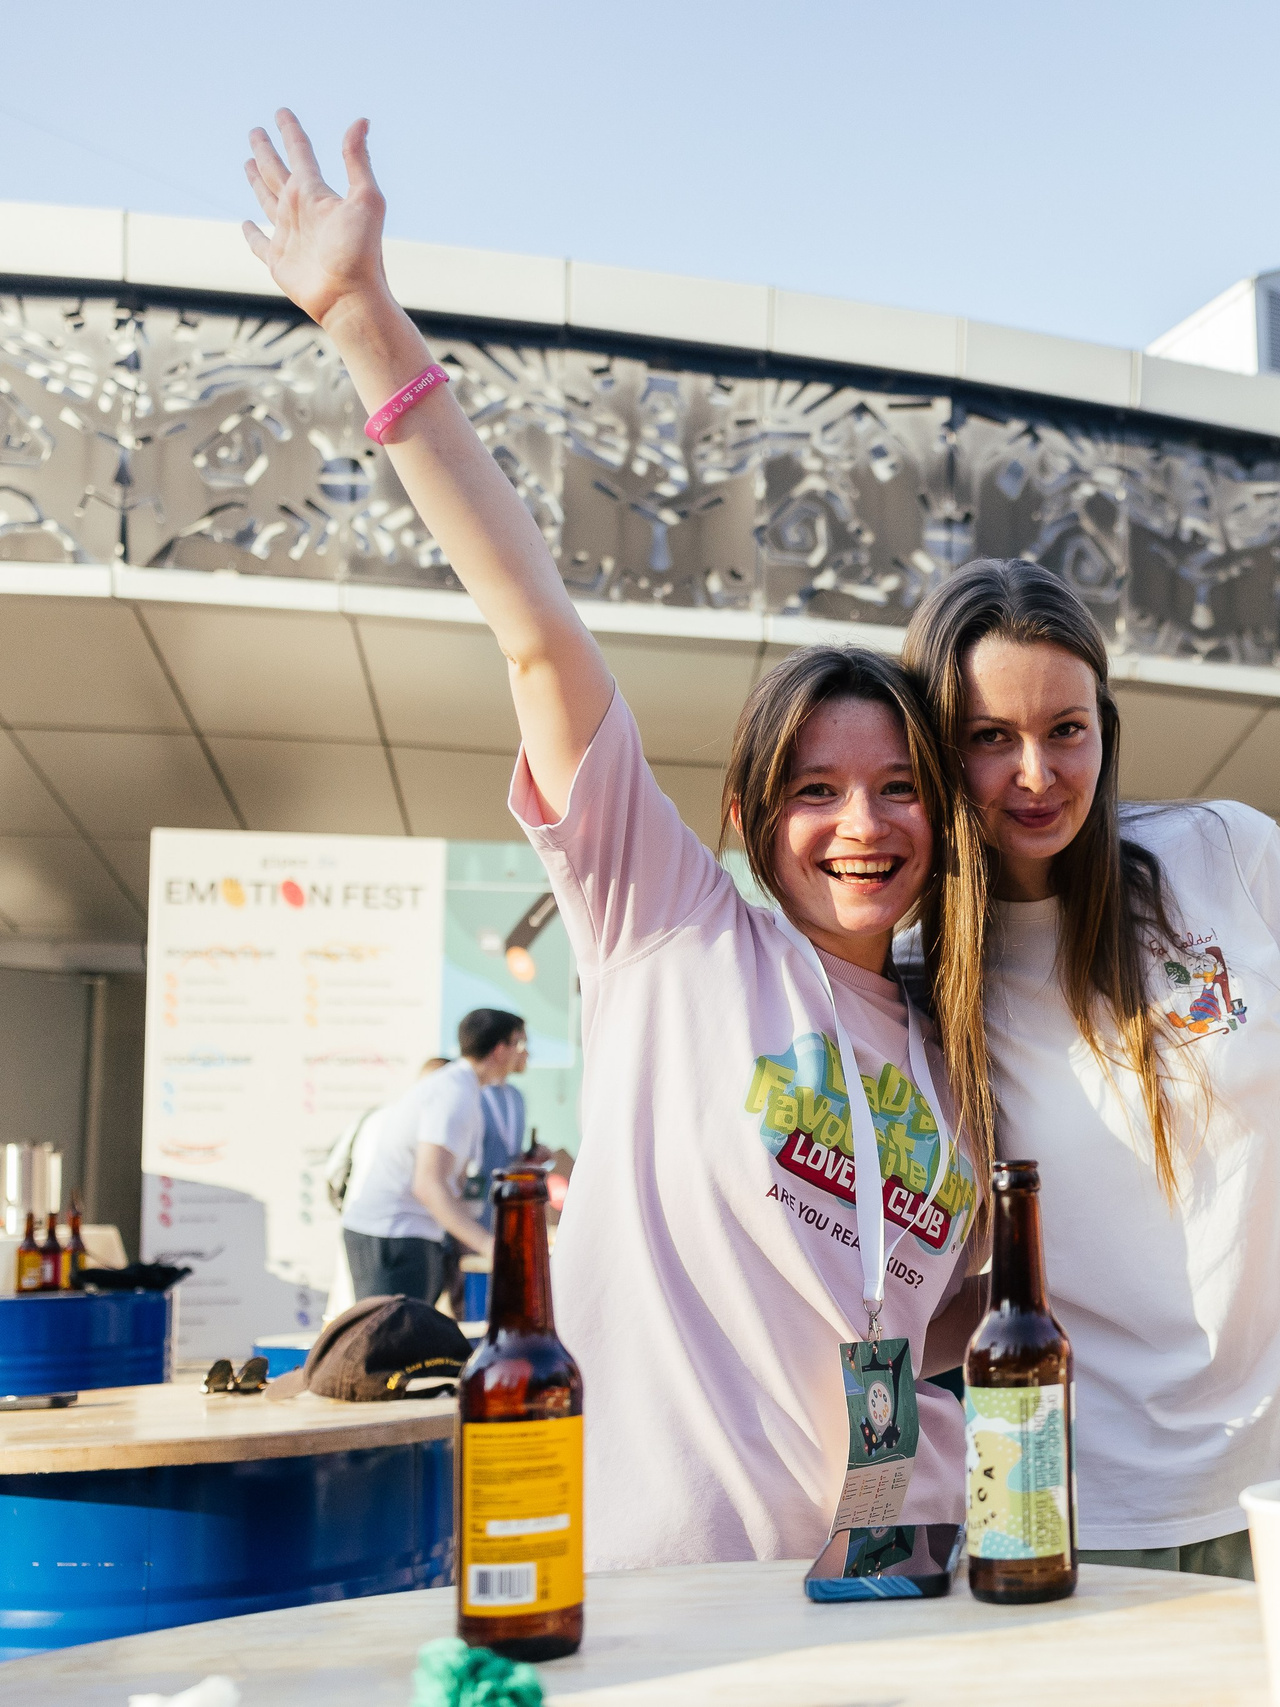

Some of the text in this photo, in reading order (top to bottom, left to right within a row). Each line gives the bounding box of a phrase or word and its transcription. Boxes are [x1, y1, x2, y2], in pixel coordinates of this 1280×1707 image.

[401, 372, 436, 403] giper.fm
[342, 882, 424, 909] FEST
[791, 1134, 945, 1239] LOVE CLUB
[765, 1183, 795, 1210] ARE
[798, 1204, 830, 1231] YOU
